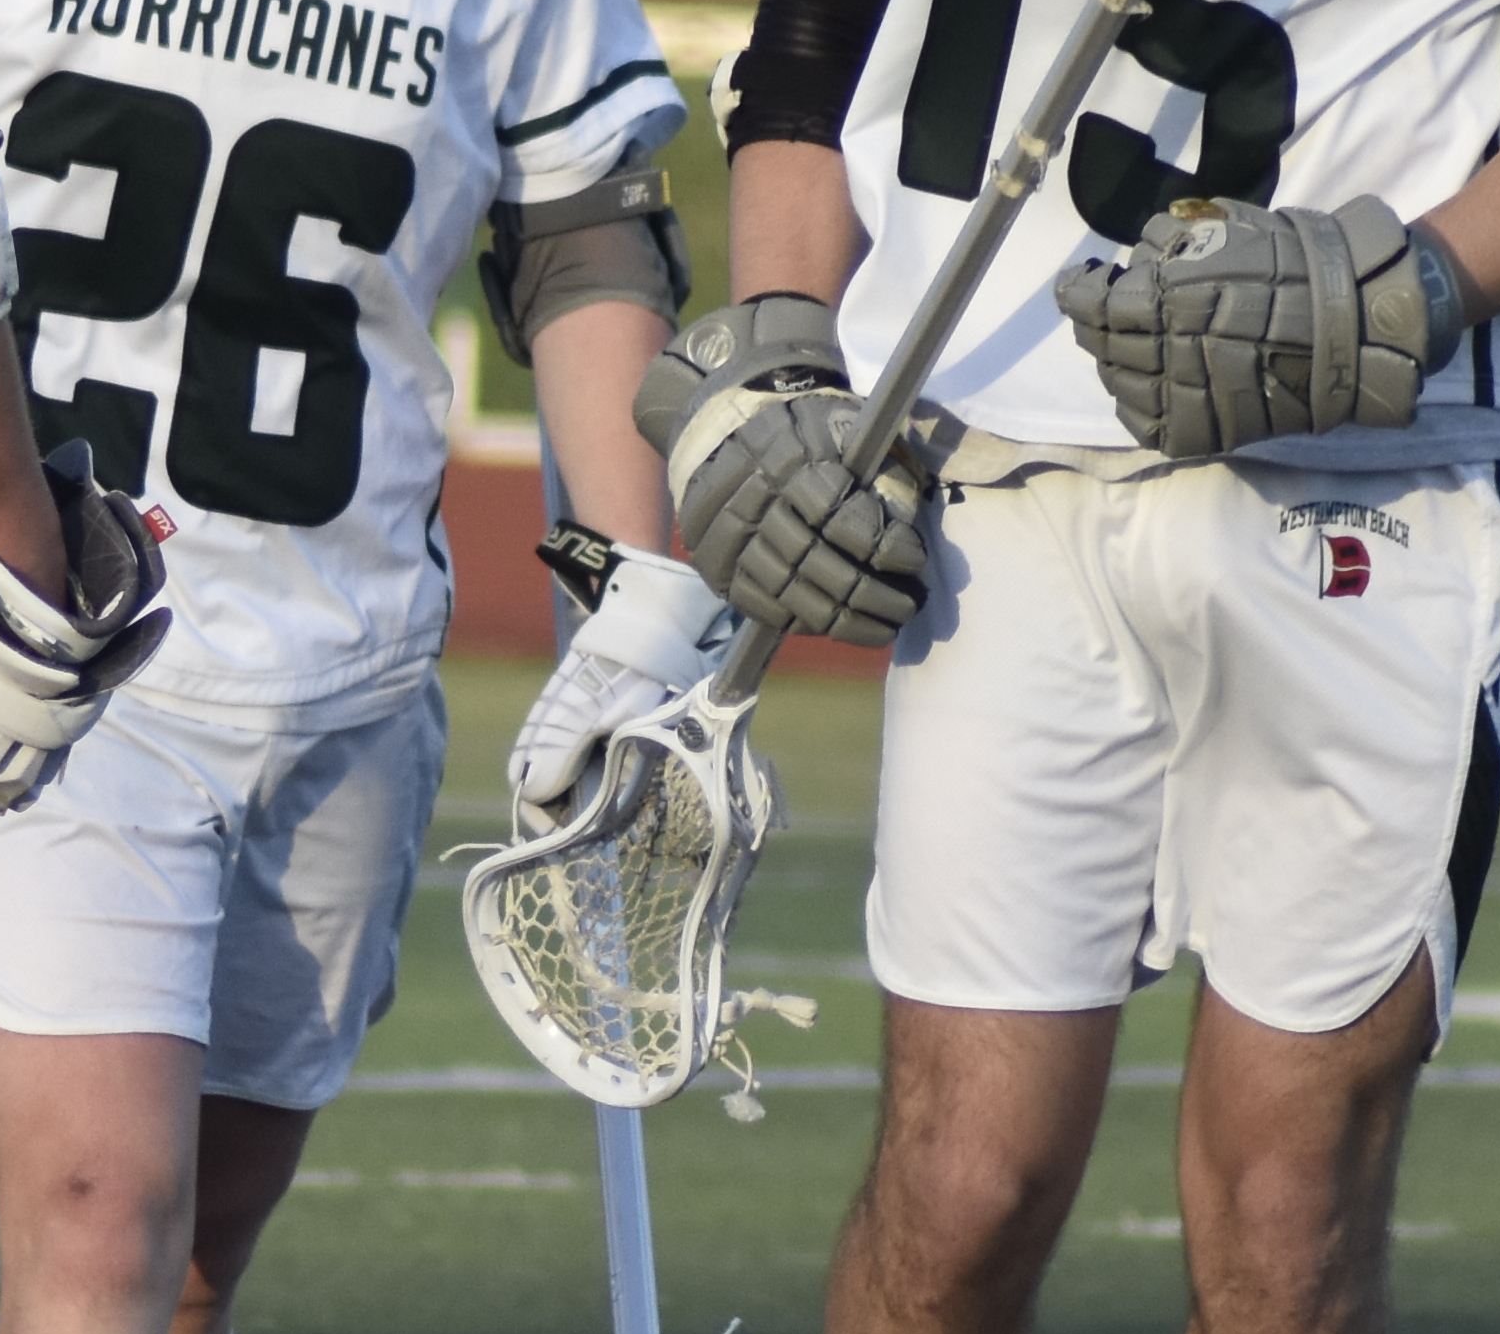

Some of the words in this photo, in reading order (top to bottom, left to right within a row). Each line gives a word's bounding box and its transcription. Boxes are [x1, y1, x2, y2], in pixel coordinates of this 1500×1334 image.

[4, 69, 416, 527] 26
[150, 509, 175, 536] STX
[1369, 508, 1410, 549] BEACH
